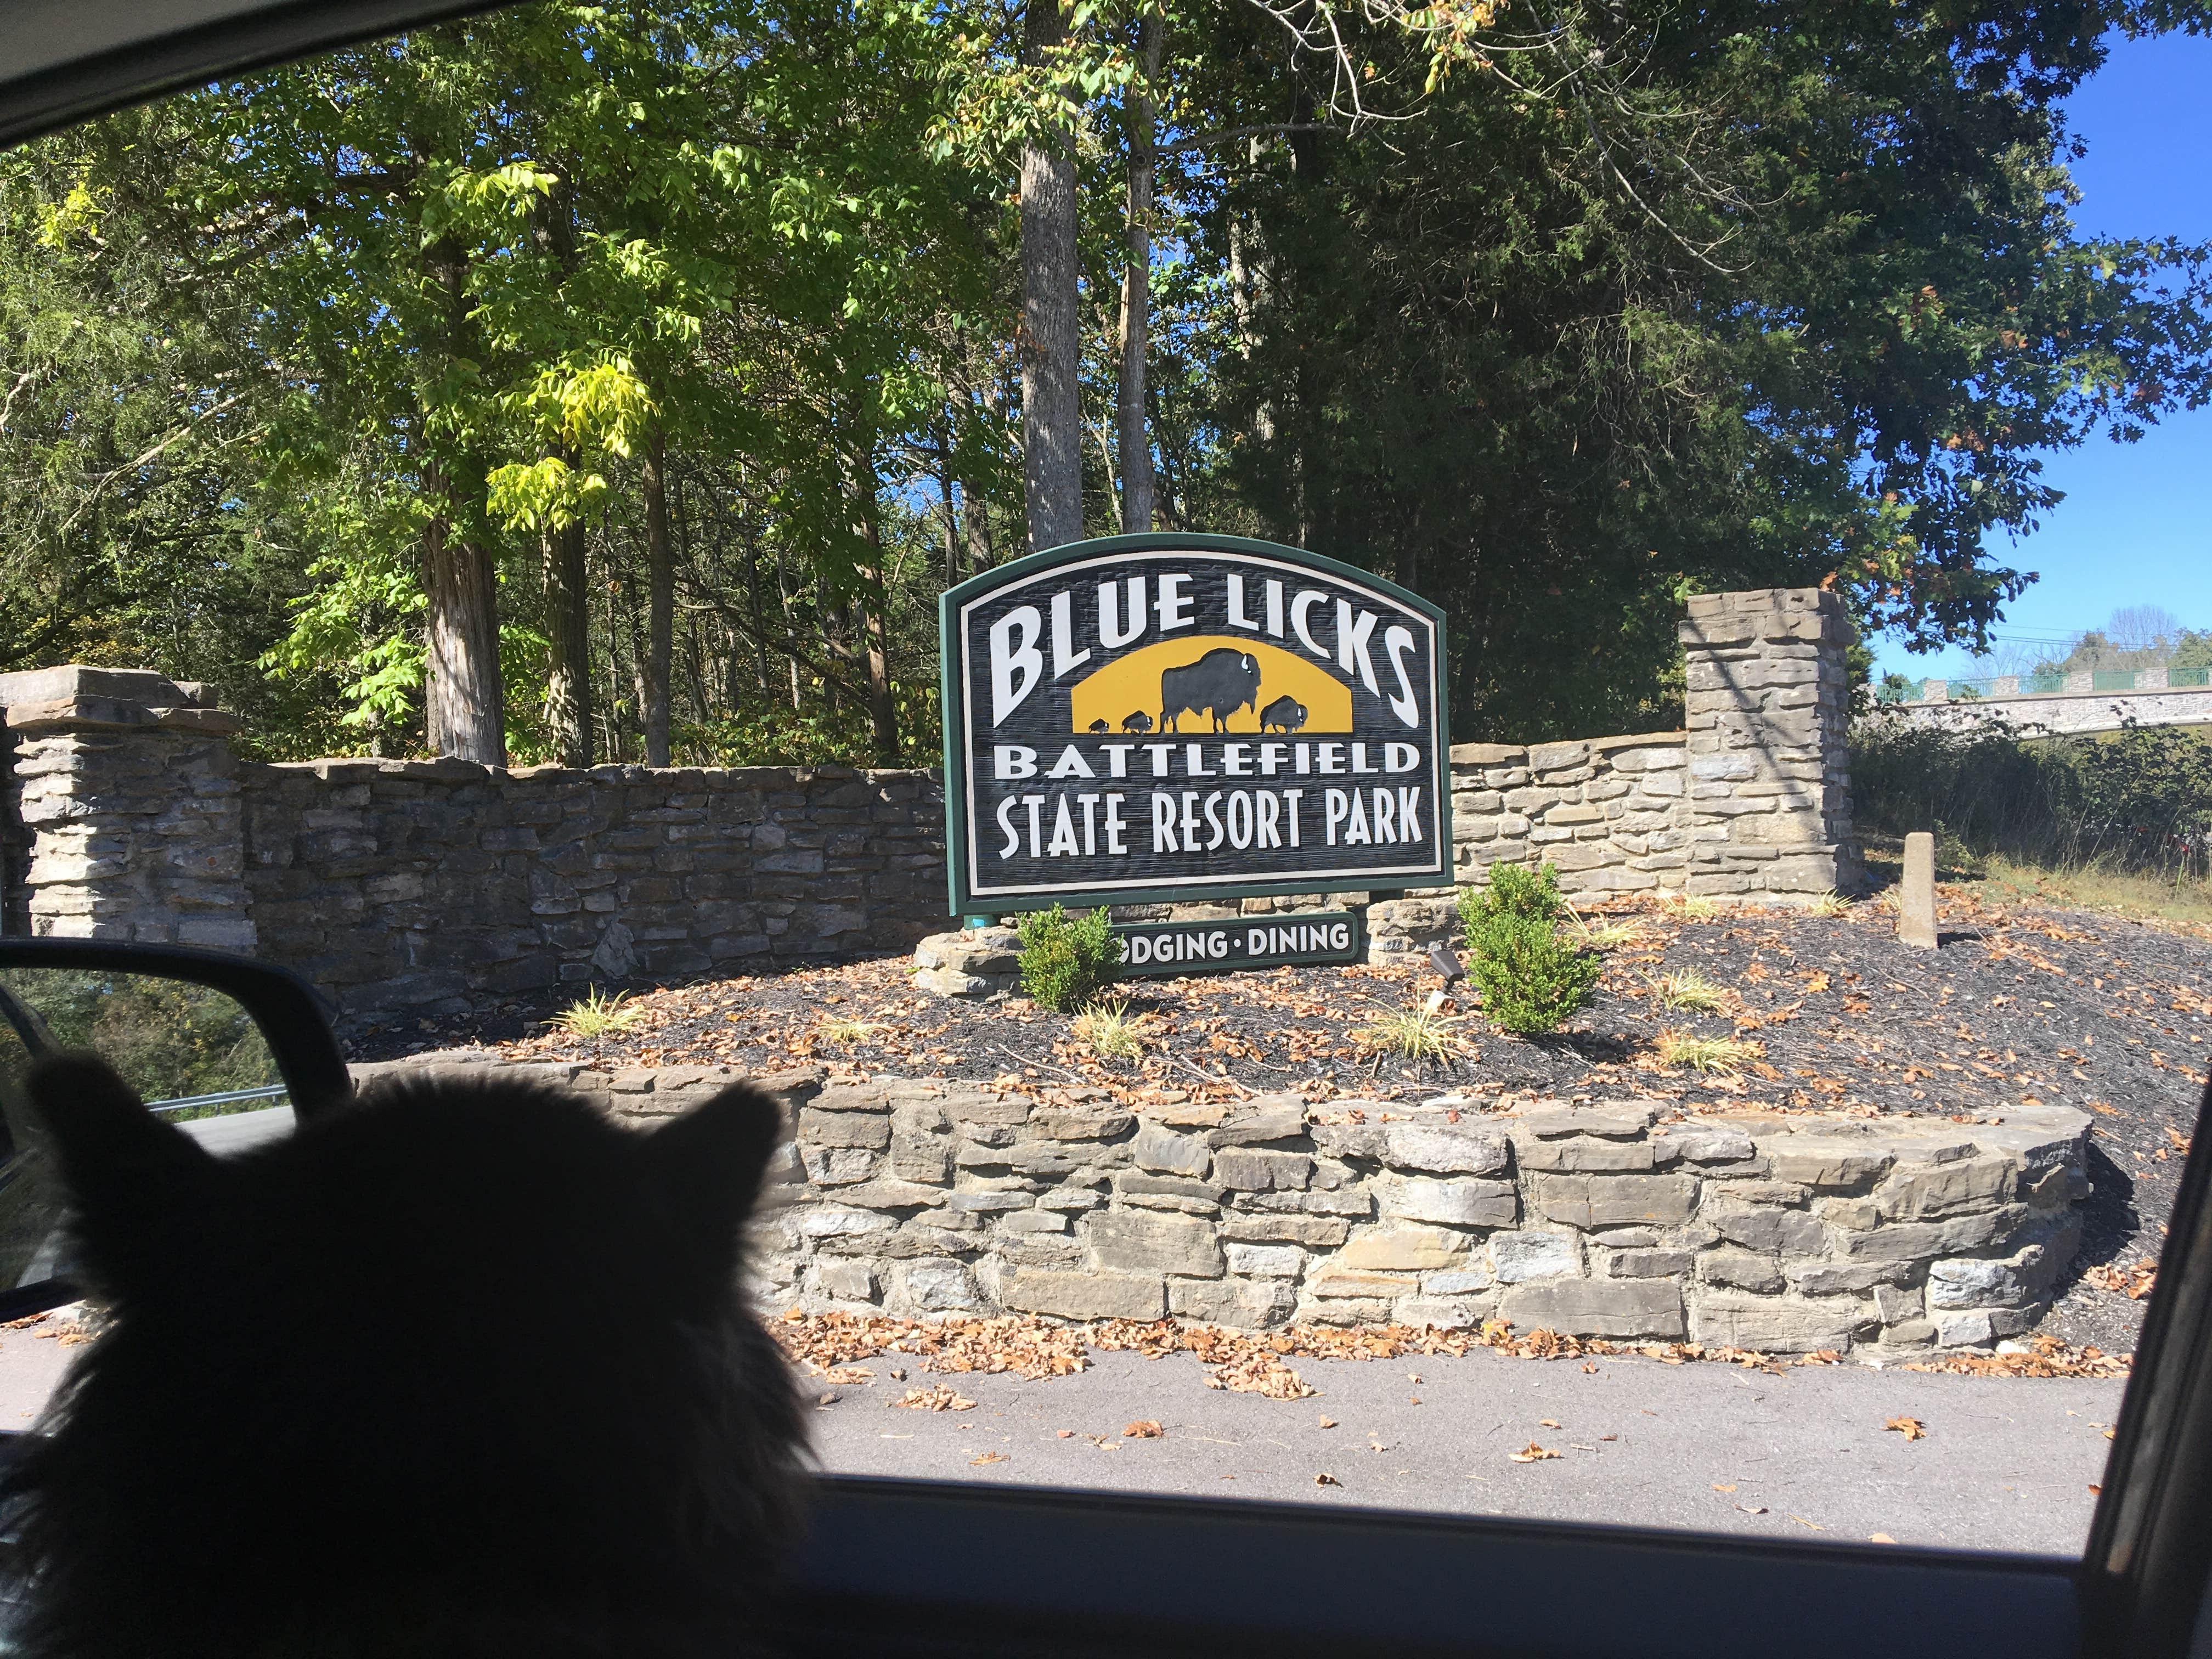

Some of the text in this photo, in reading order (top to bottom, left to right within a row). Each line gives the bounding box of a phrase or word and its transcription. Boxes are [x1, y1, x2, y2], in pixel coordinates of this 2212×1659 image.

[990, 573, 1419, 729] BLUE LICKS
[994, 742, 1420, 780] BATTLEFIELD
[996, 786, 1423, 859] STATE RESORT PARK
[1248, 923, 1348, 956] DINING
